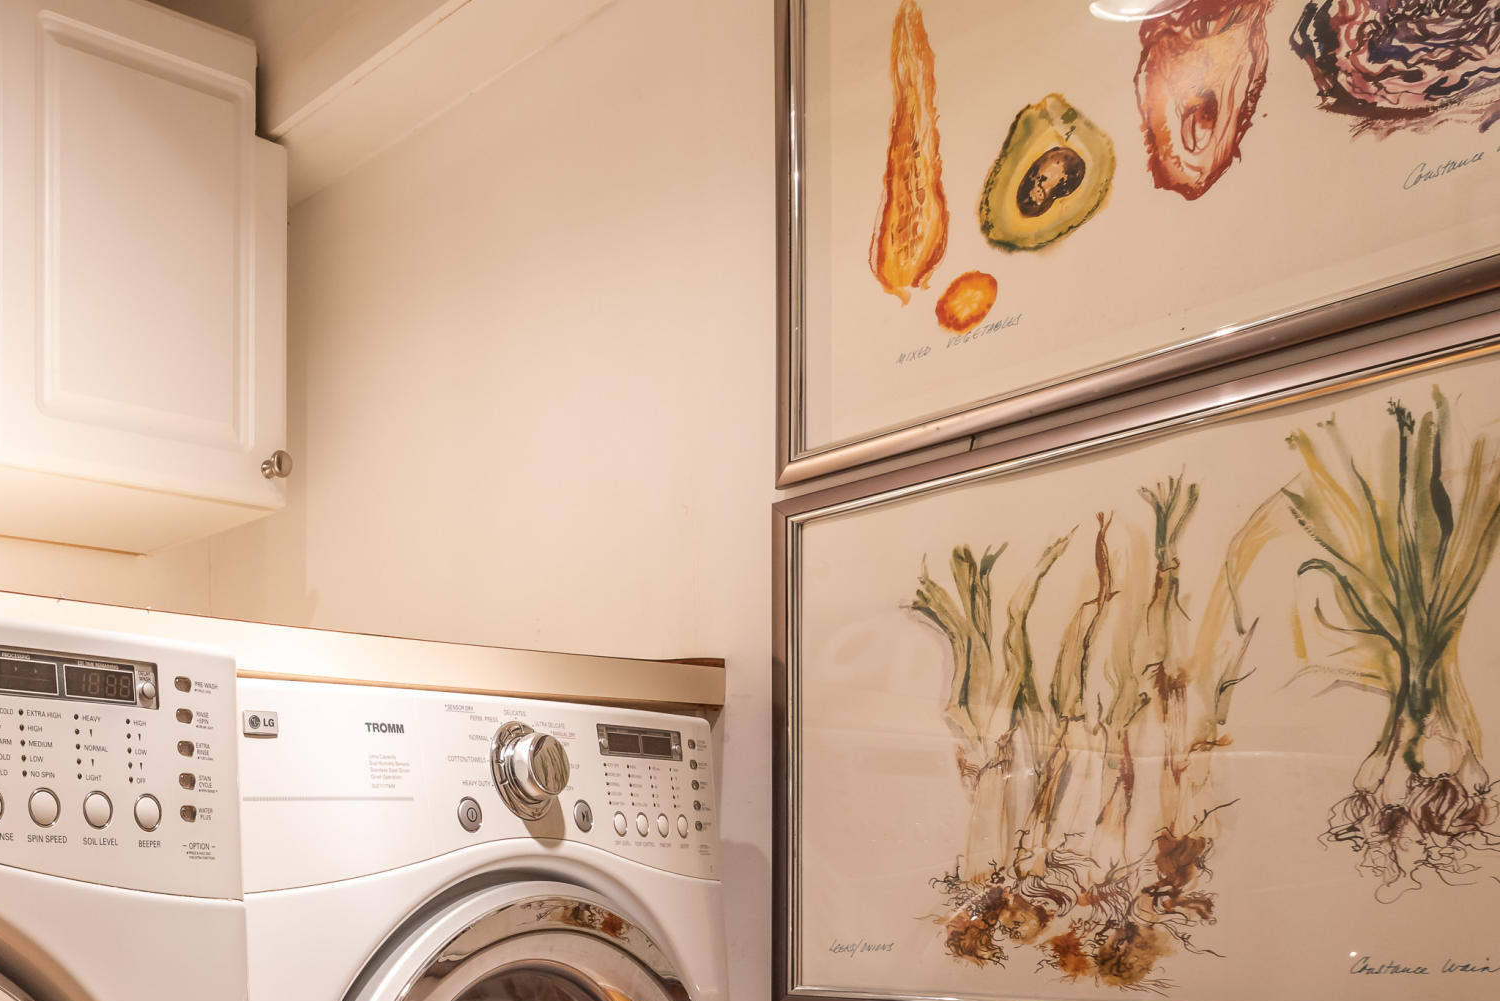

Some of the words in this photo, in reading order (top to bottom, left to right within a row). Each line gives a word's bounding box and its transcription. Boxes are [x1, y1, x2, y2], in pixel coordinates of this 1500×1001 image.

[26, 709, 46, 718] EXTRA
[47, 711, 62, 719] HIGH
[82, 715, 101, 723] HEAVY
[133, 719, 147, 727] HIGH
[263, 718, 275, 727] LG
[27, 725, 43, 733] HIGH
[365, 722, 405, 734] TROMM
[28, 740, 53, 748] MEDIUM
[83, 744, 108, 753] NORMAL
[134, 748, 147, 756] LOW
[29, 755, 44, 763] LOW
[85, 774, 102, 782] LIGHT
[27, 834, 44, 843] SPIN
[45, 835, 68, 844] SPEED
[82, 837, 98, 846] SOIL
[99, 837, 119, 846] LEVEL
[138, 839, 161, 848] BEEPER
[188, 842, 210, 850] OPTION
